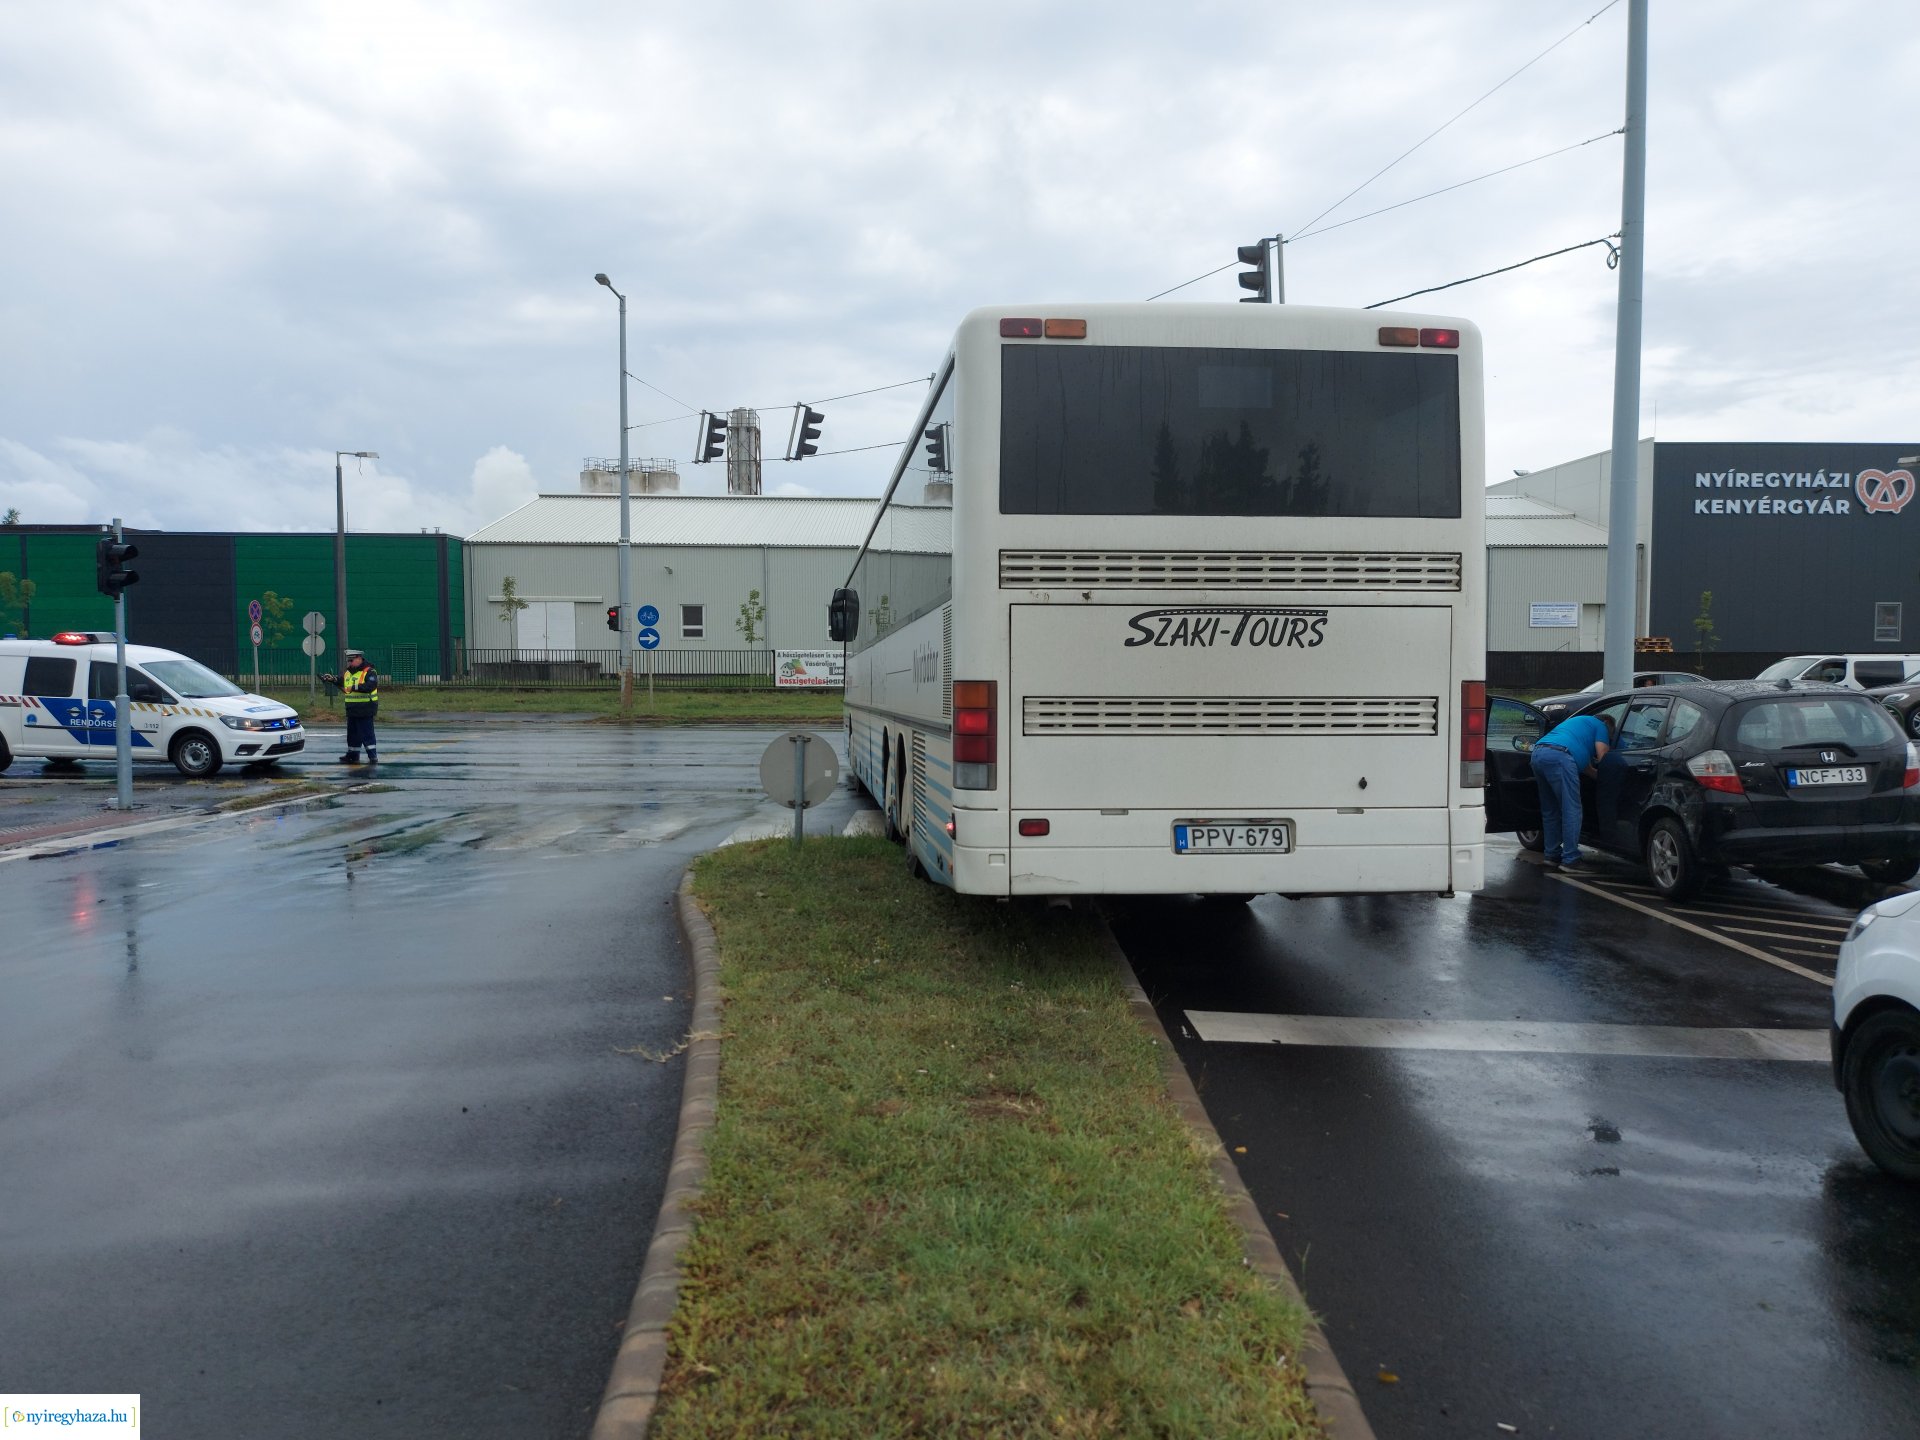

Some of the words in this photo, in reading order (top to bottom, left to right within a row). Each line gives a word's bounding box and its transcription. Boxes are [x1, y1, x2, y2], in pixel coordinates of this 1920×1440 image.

[1695, 468, 1850, 488] NYÍREGYHÁZI
[1694, 496, 1850, 514] KENYÉRGYÁR
[1124, 608, 1328, 648] SZAKI-TOURS
[70, 718, 117, 728] RENDŐRSÉ
[1799, 769, 1863, 784] NCF-133
[1191, 828, 1283, 847] PPV-679
